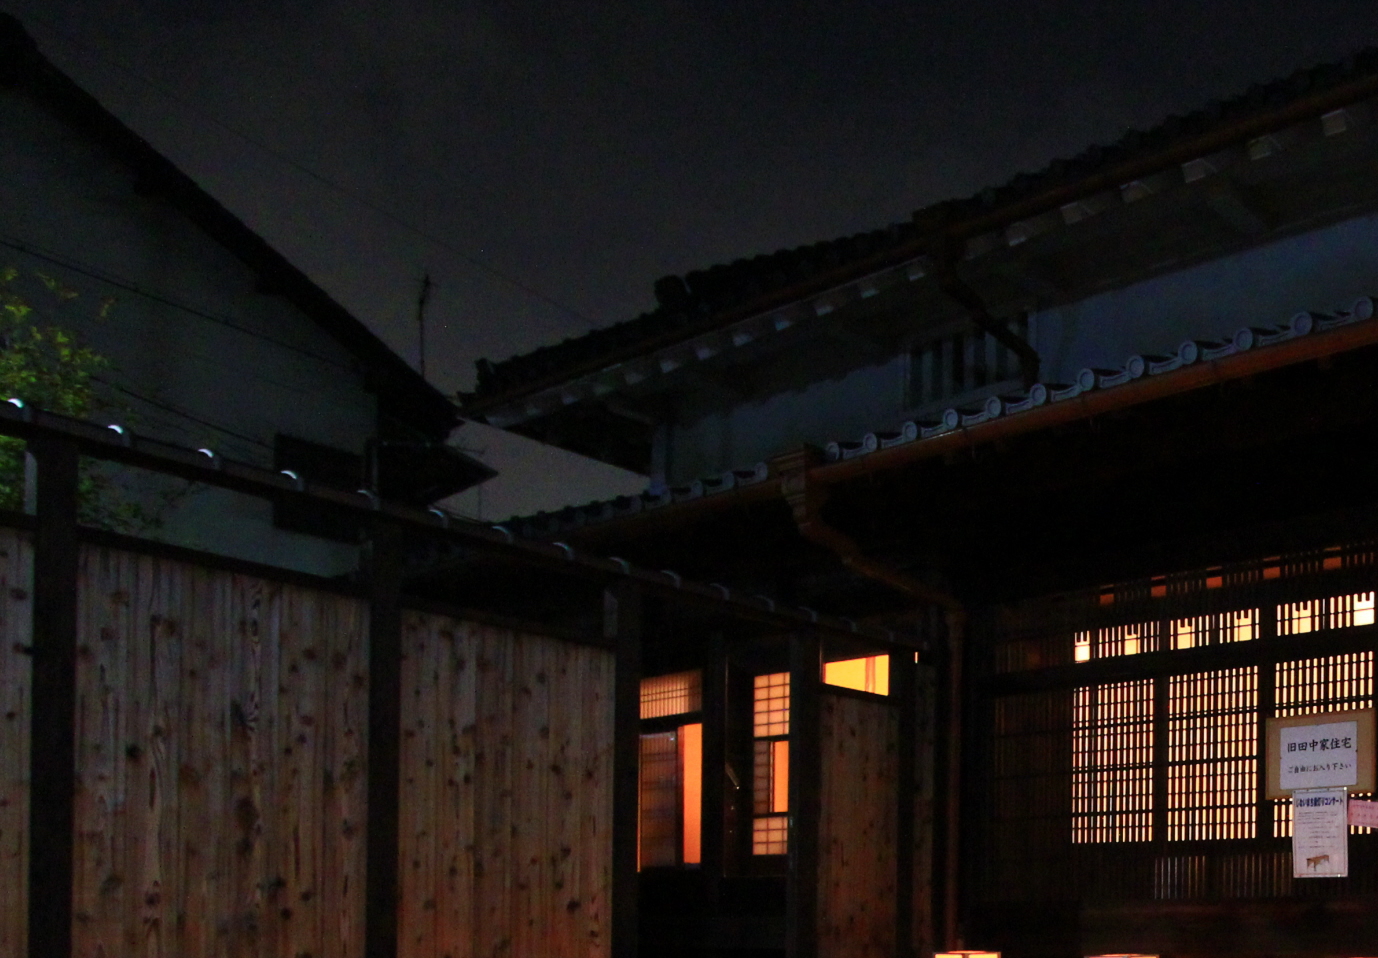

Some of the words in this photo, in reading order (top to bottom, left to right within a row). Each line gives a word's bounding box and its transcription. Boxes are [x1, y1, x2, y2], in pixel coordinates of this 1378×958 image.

[1287, 737, 1352, 753] 旧田中家住宅
[1287, 762, 1352, 774] ご自由にお入り下さい
